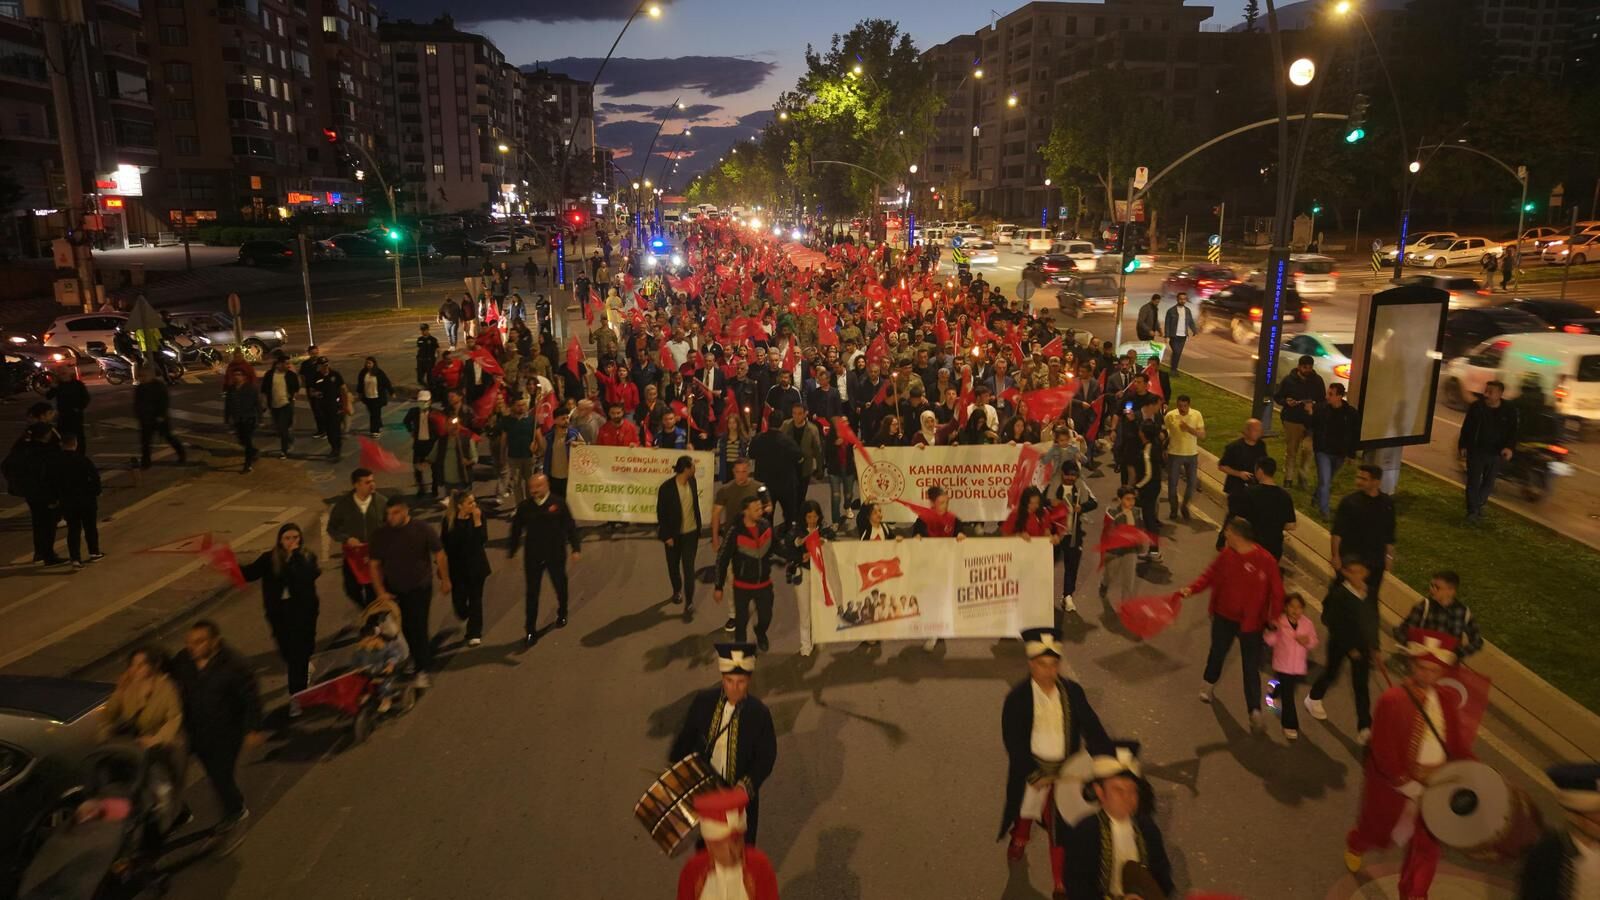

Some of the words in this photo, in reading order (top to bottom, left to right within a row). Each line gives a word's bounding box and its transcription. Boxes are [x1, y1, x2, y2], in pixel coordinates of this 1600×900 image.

[909, 463, 1018, 475] KAHRAMANMARA
[916, 476, 968, 488] GENÇLİK
[971, 478, 984, 486] ve
[987, 476, 1012, 487] SPO
[575, 483, 624, 495] BATIPARK
[945, 486, 1008, 499] ÜDÜRLÜĞ
